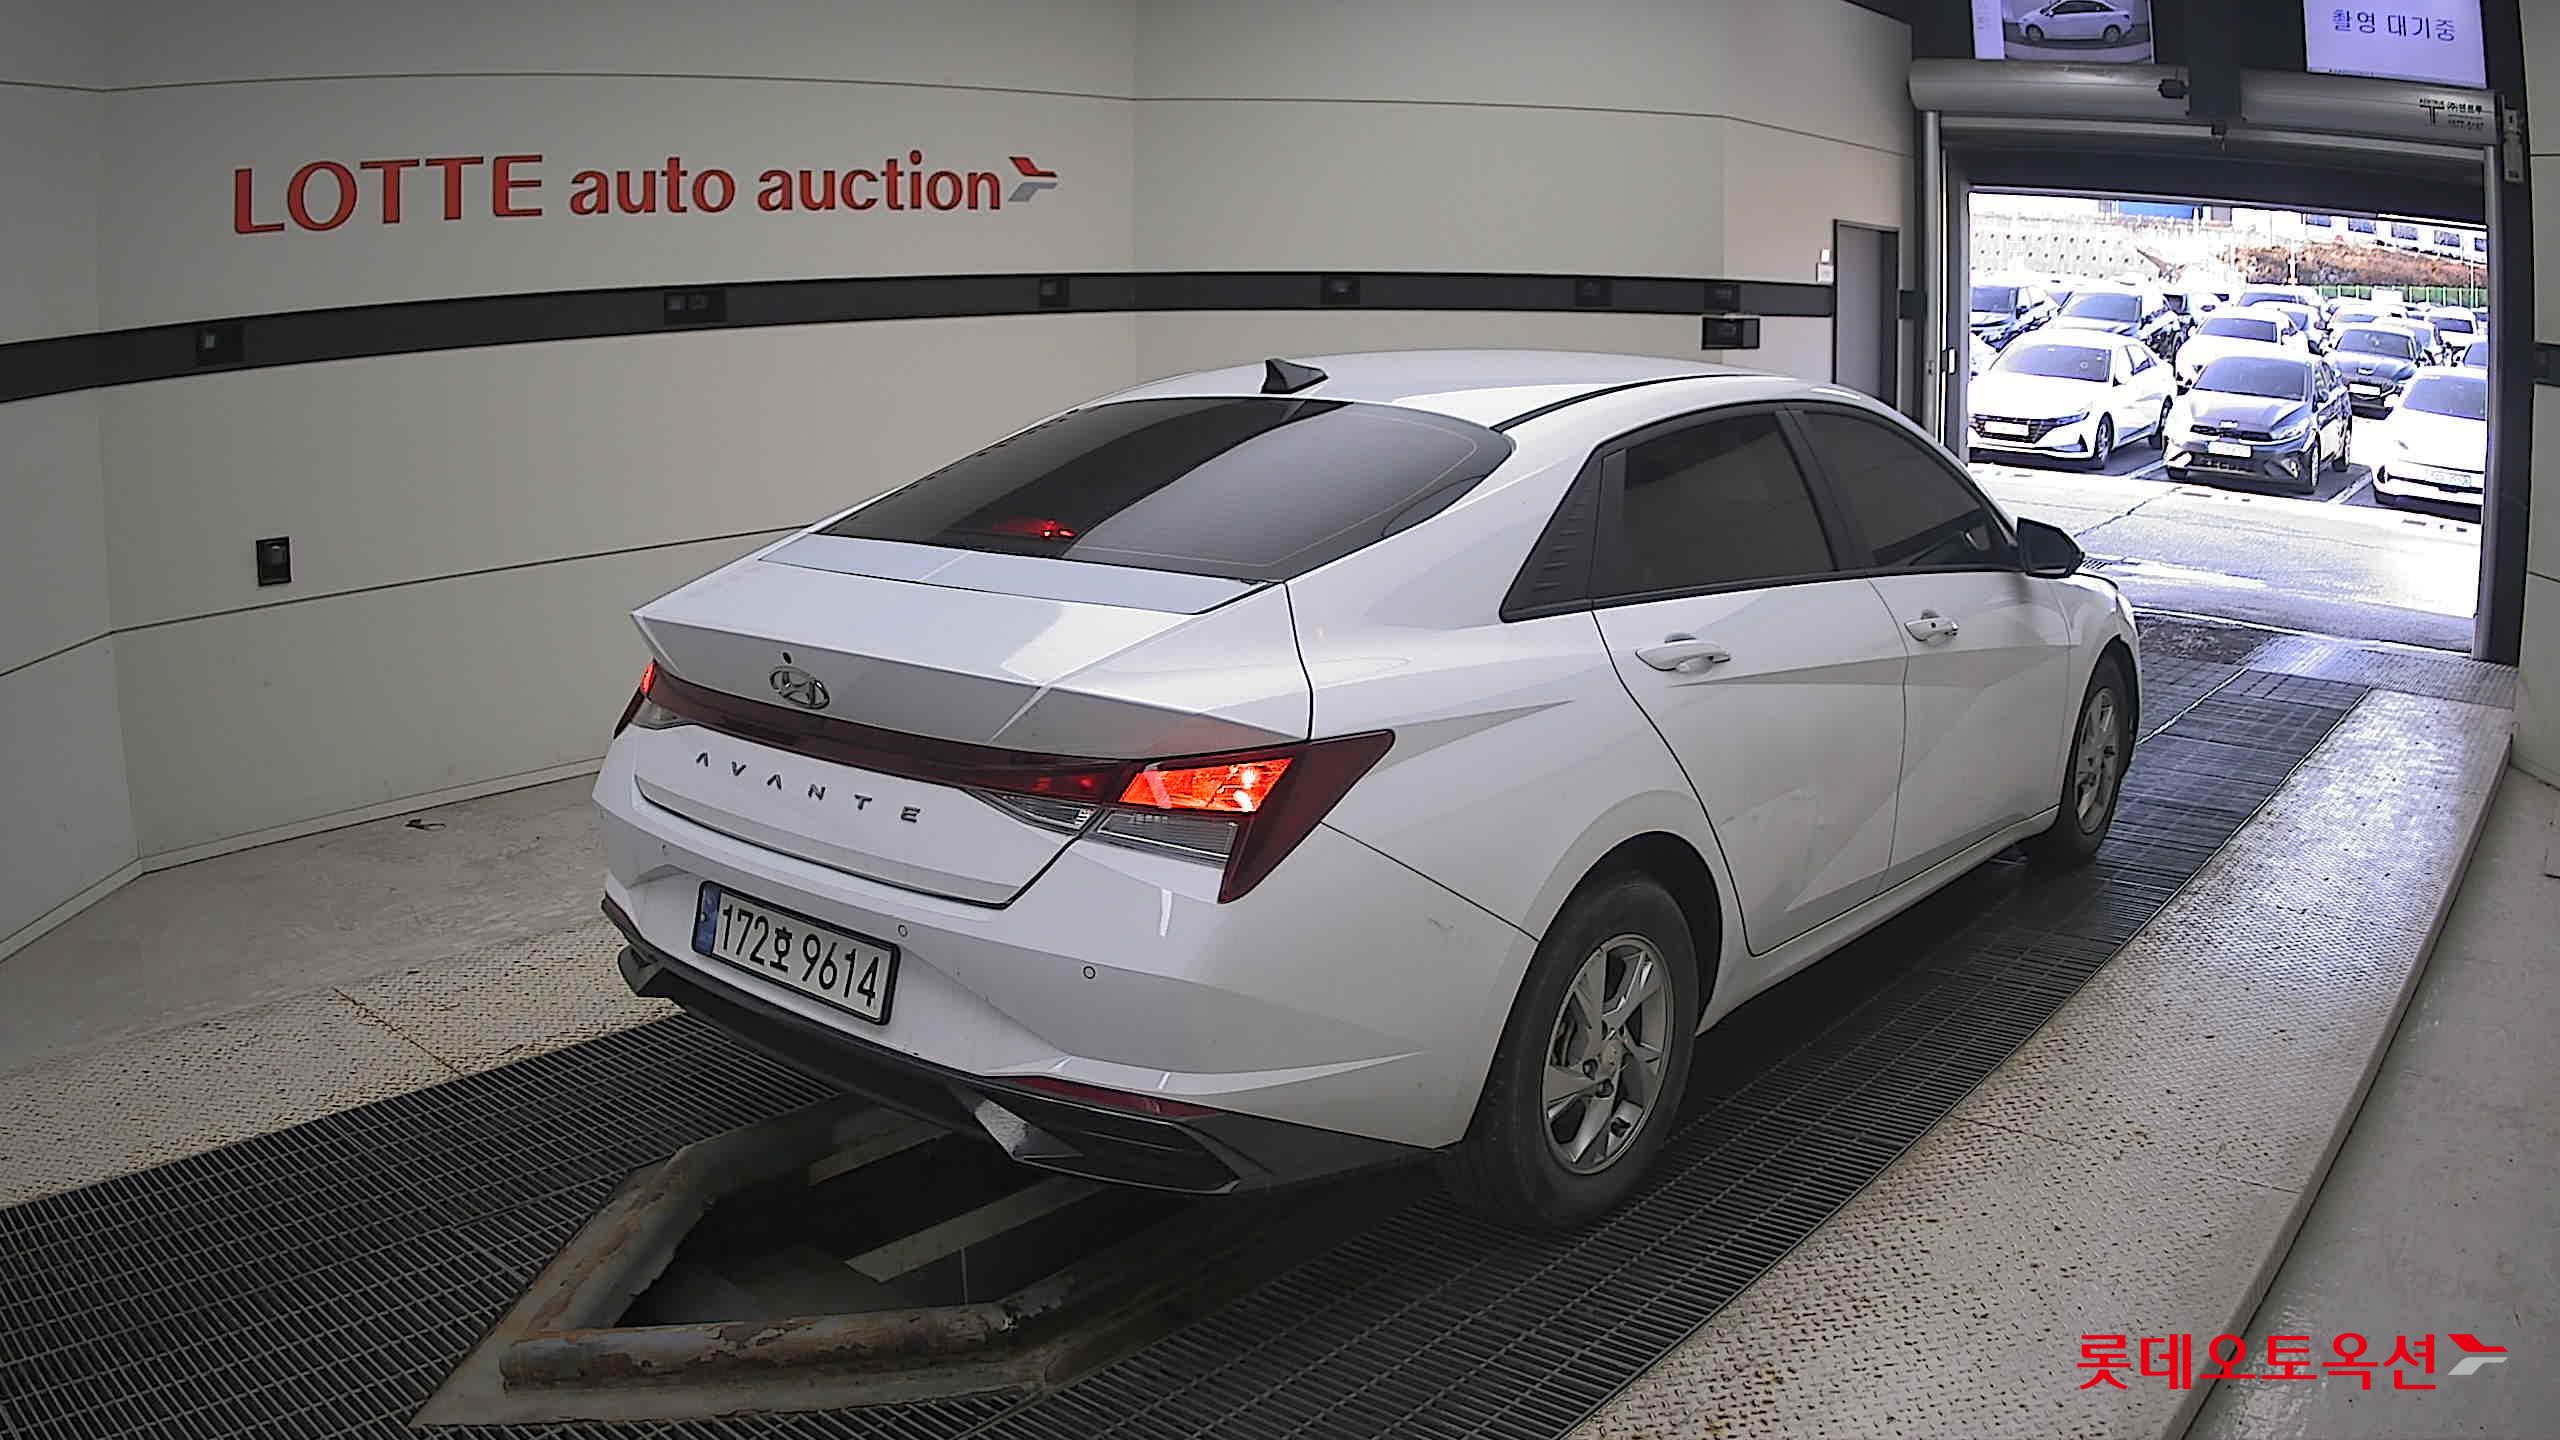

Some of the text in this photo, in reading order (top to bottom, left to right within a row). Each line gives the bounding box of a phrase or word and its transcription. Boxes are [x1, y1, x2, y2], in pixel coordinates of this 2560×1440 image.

[2333, 8, 2456, 42] 촬영 대기중
[233, 149, 1002, 235] LOTTE auto auction
[695, 750, 922, 823] AVANTE
[722, 904, 880, 1008] 172호 9614
